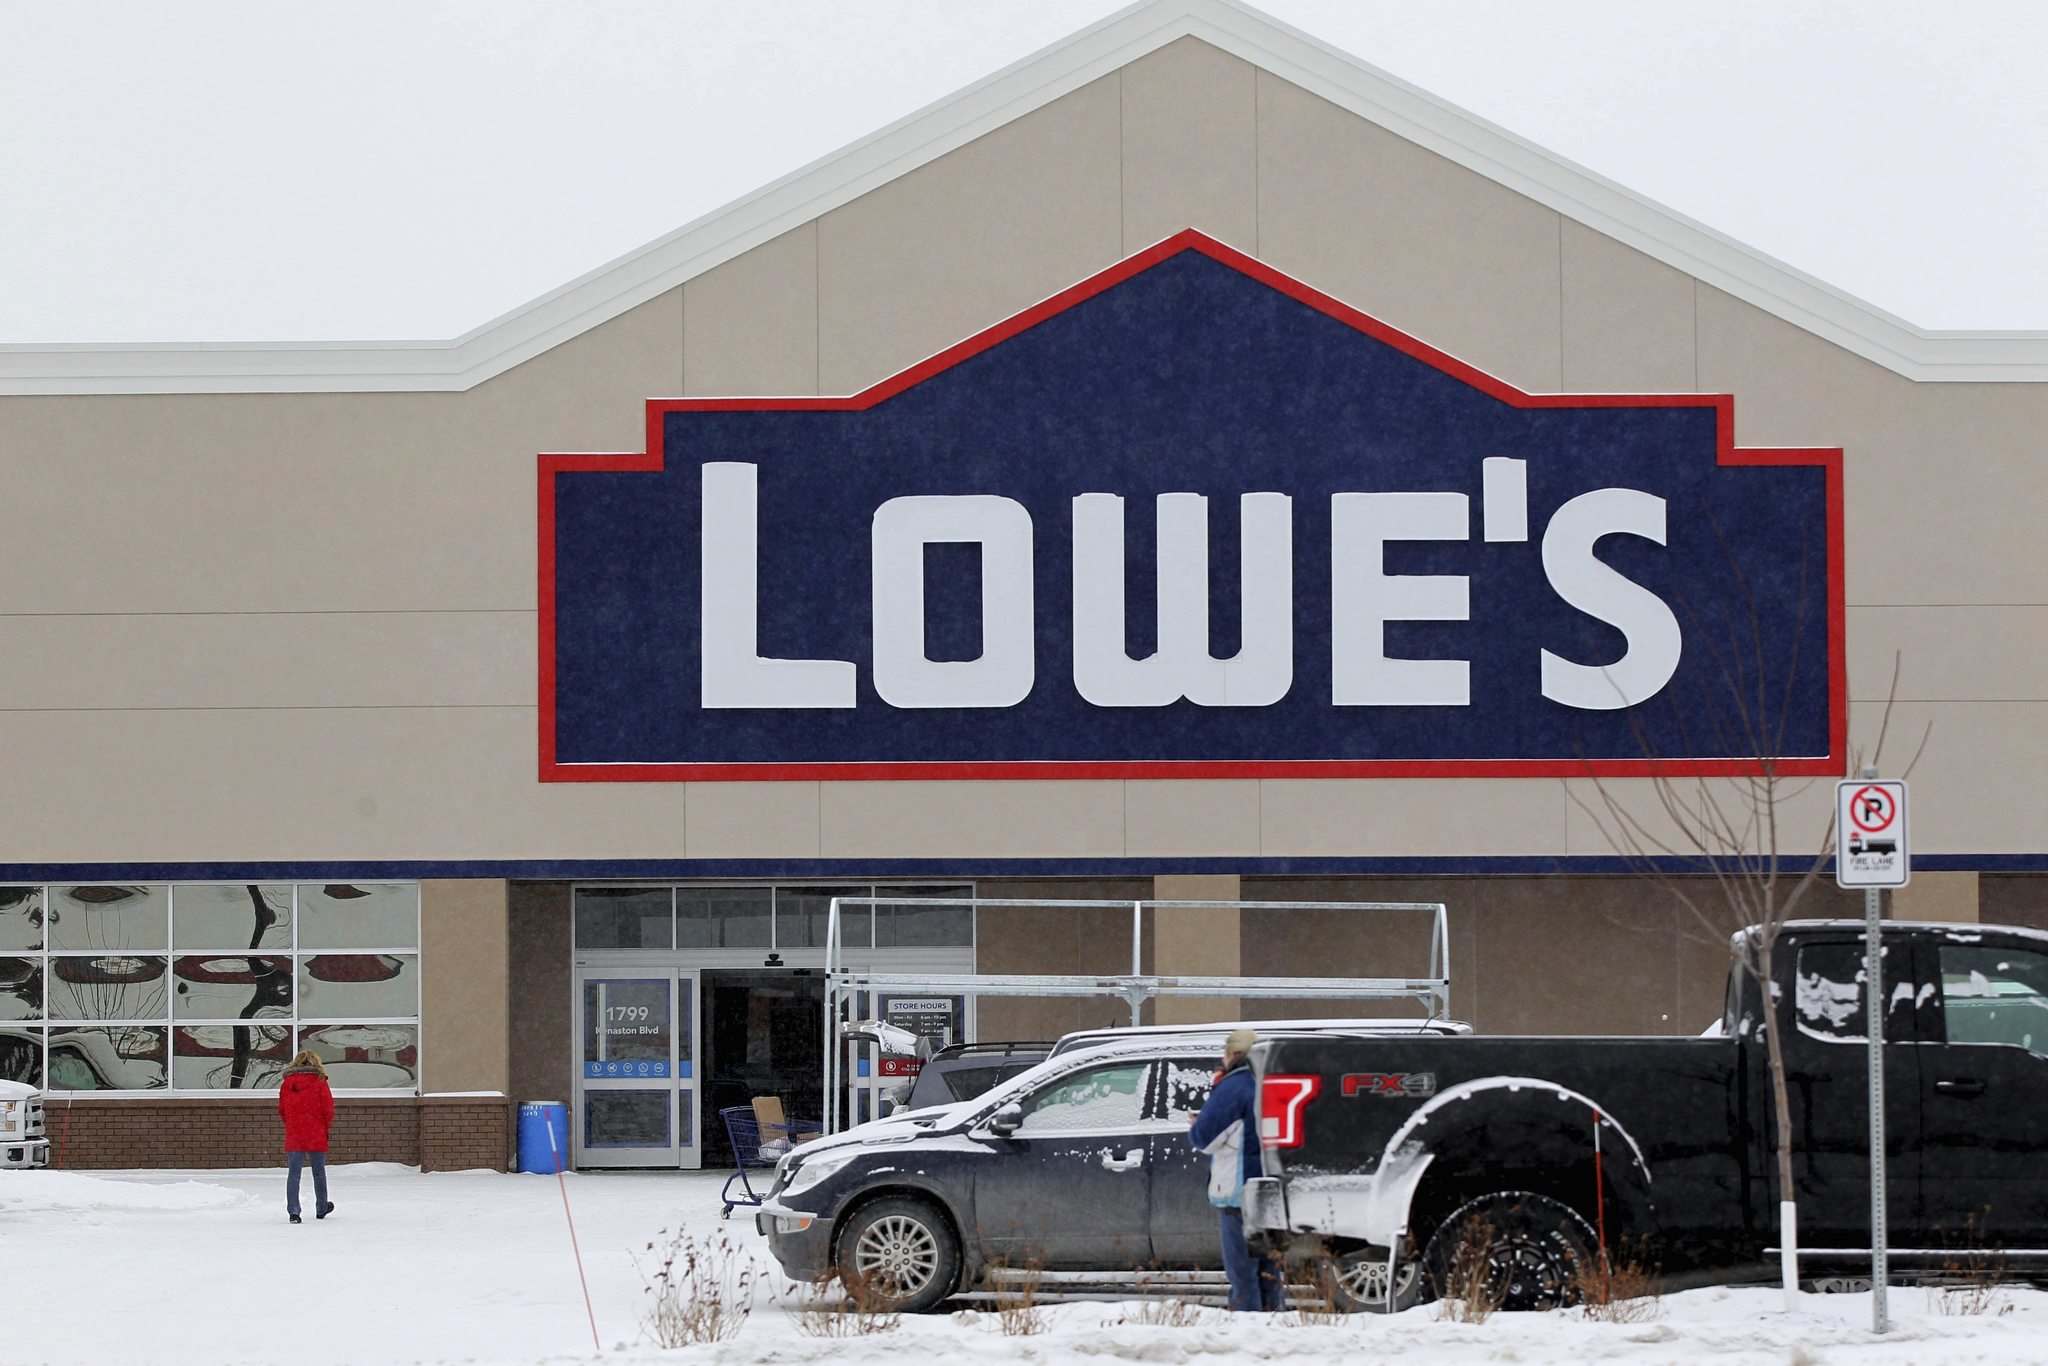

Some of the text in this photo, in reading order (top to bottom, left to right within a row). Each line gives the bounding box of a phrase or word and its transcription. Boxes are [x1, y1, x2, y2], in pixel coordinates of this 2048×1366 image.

[701, 456, 1682, 710] LOWE'S
[606, 1006, 649, 1021] 1799
[894, 1002, 947, 1010] STORE HOURS
[595, 1026, 659, 1035] Knaston Blvd
[1341, 1072, 1437, 1097] FX4
